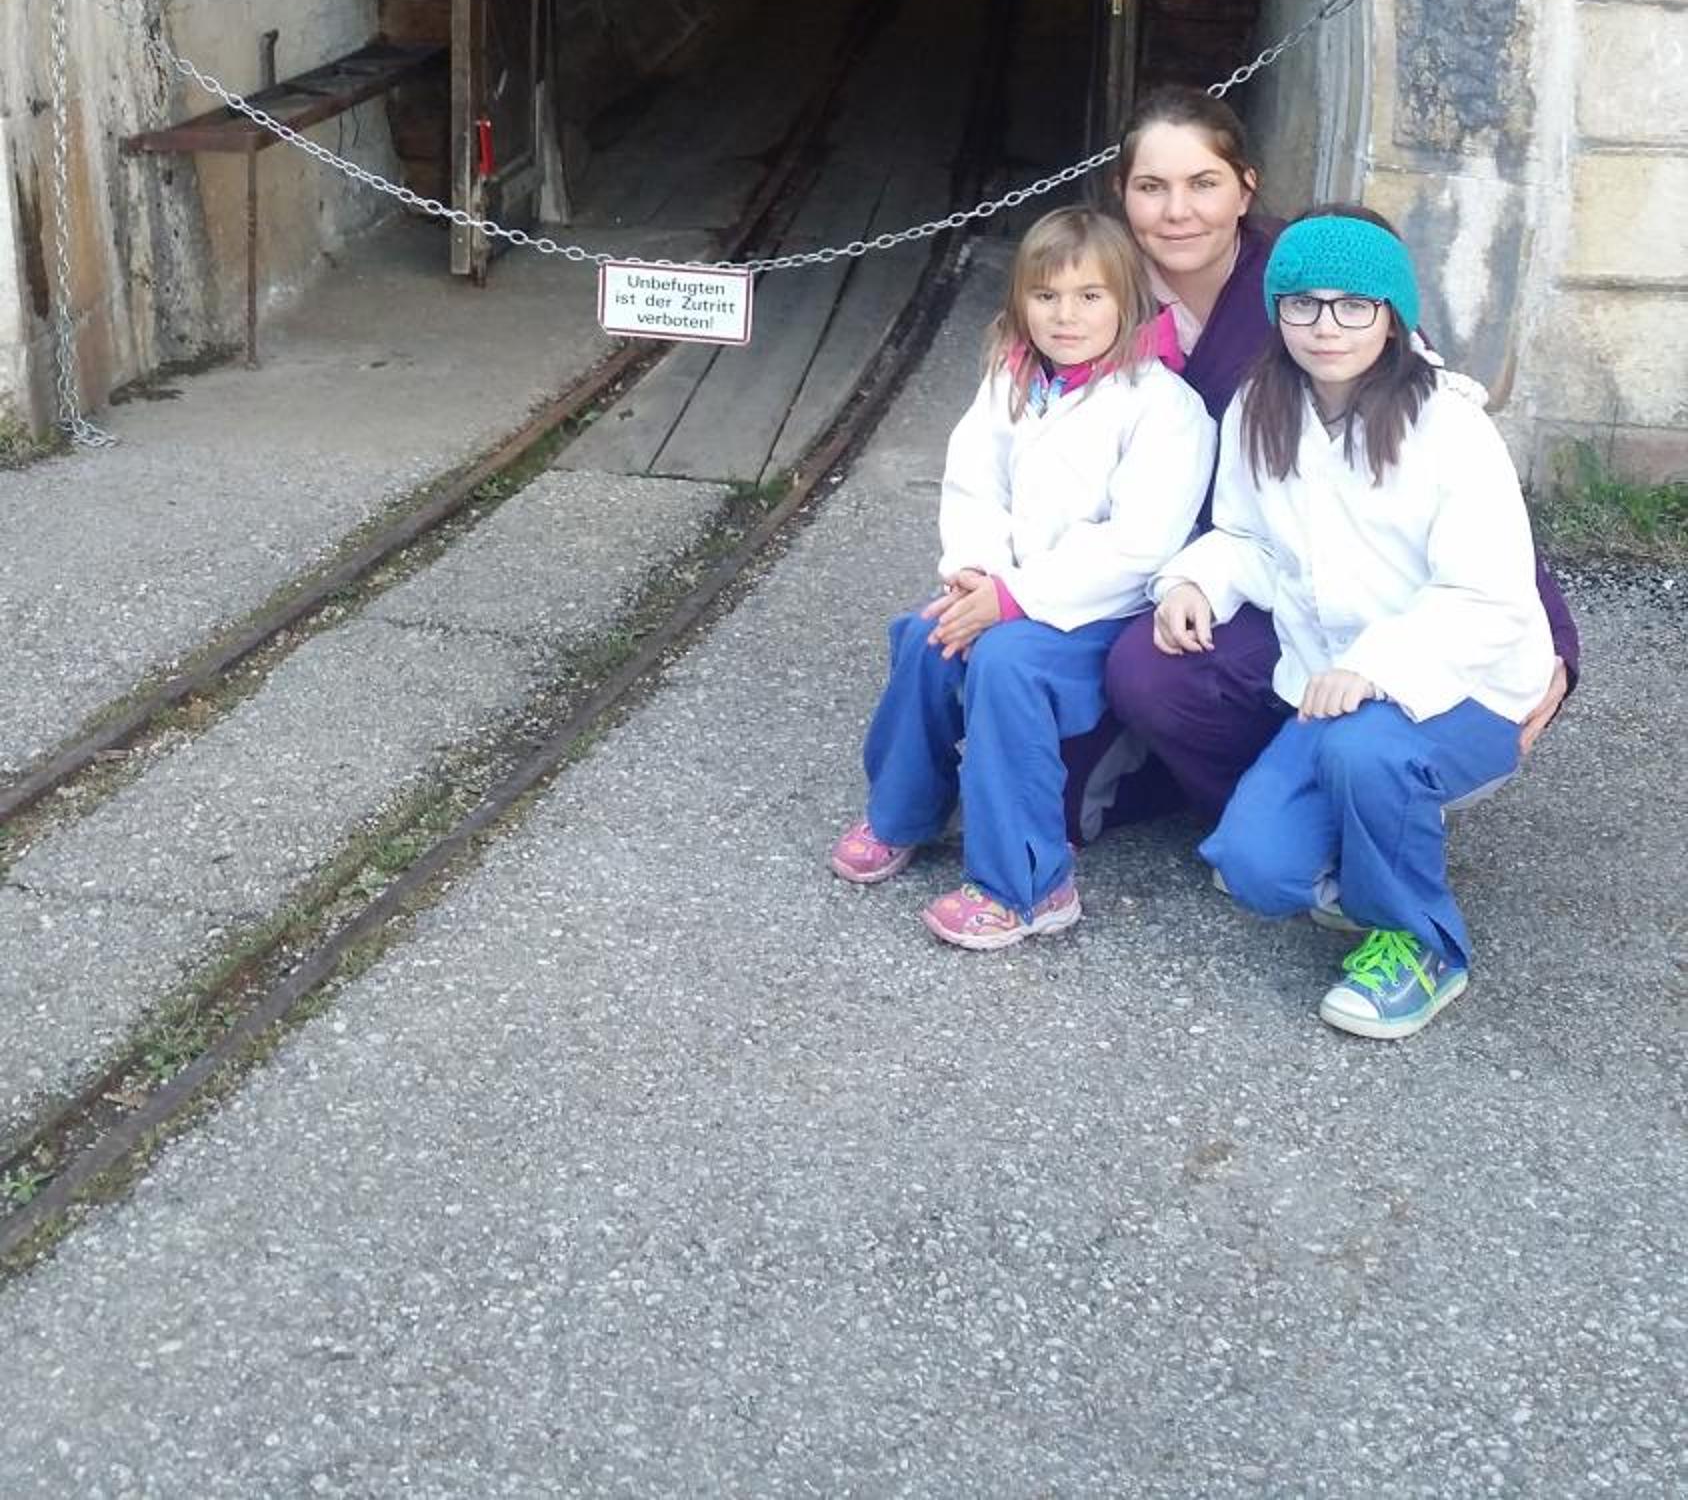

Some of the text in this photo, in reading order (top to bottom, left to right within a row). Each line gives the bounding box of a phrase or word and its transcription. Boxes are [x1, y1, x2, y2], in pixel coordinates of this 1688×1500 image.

[627, 275, 726, 296] Unbefugten
[615, 293, 735, 314] ist der Zutritt
[637, 313, 714, 330] verboten!
